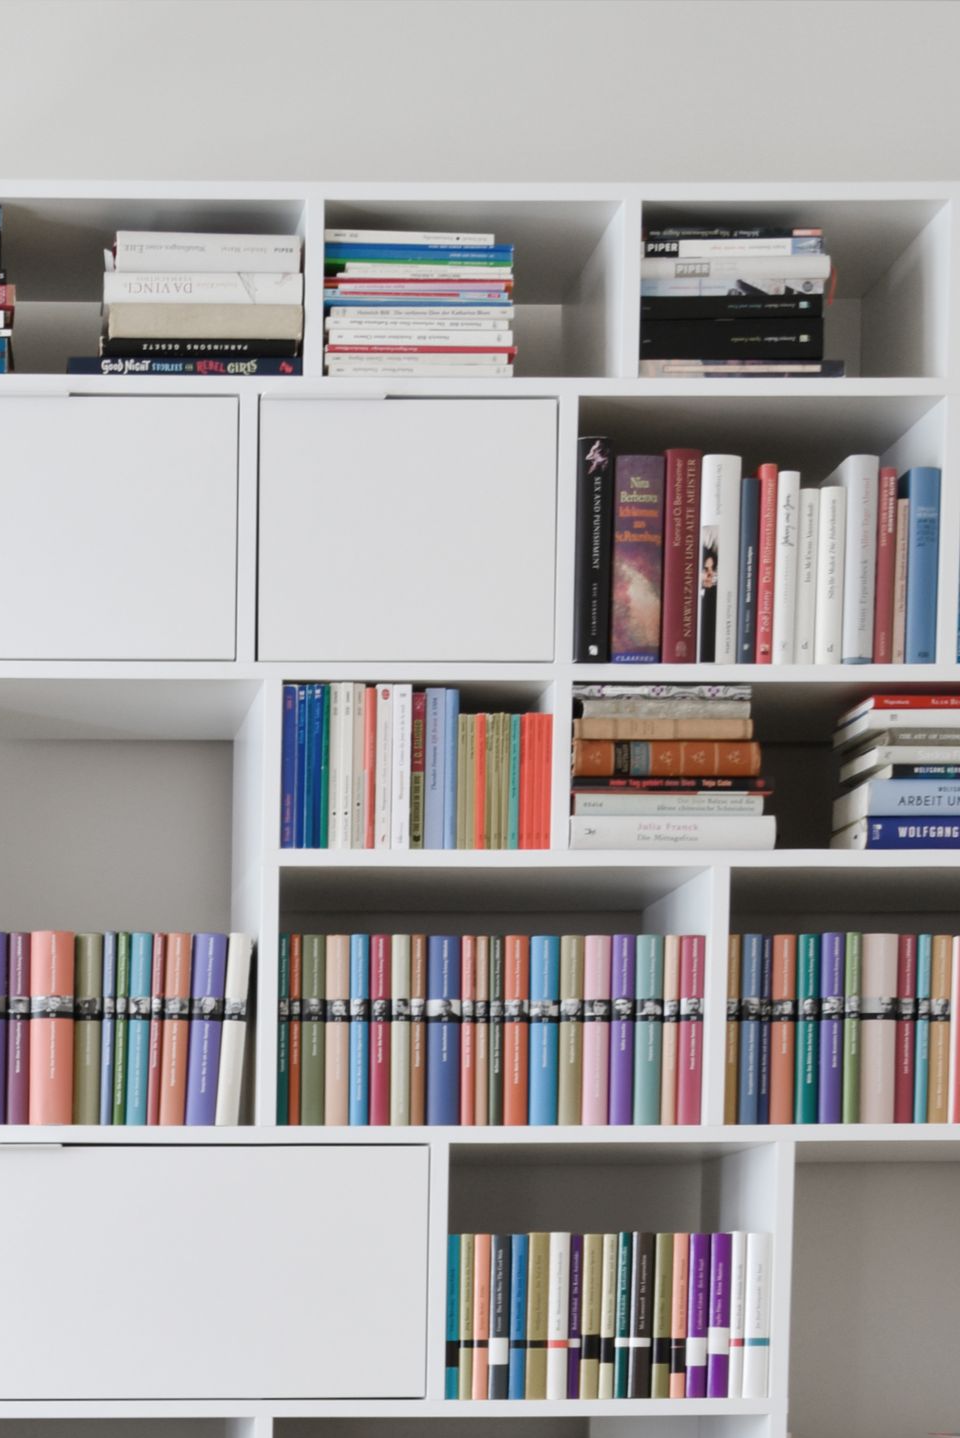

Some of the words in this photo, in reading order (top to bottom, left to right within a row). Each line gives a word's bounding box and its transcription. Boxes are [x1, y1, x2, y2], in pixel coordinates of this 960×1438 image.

[647, 243, 678, 252] PIPER
[676, 264, 709, 273] PIPER
[592, 476, 601, 492] SEX
[686, 459, 696, 504] MEISTER
[592, 494, 601, 512] AND
[685, 508, 695, 532] ALTE
[592, 515, 601, 569] PUNISHMENT
[685, 535, 694, 559] UND
[683, 563, 693, 637] NARWALZAHN
[414, 720, 422, 749] SALINGER
[898, 796, 942, 806] ARBEIT
[654, 834, 698, 842] Mittagsfrau
[898, 826, 959, 838] WOLFGANG
